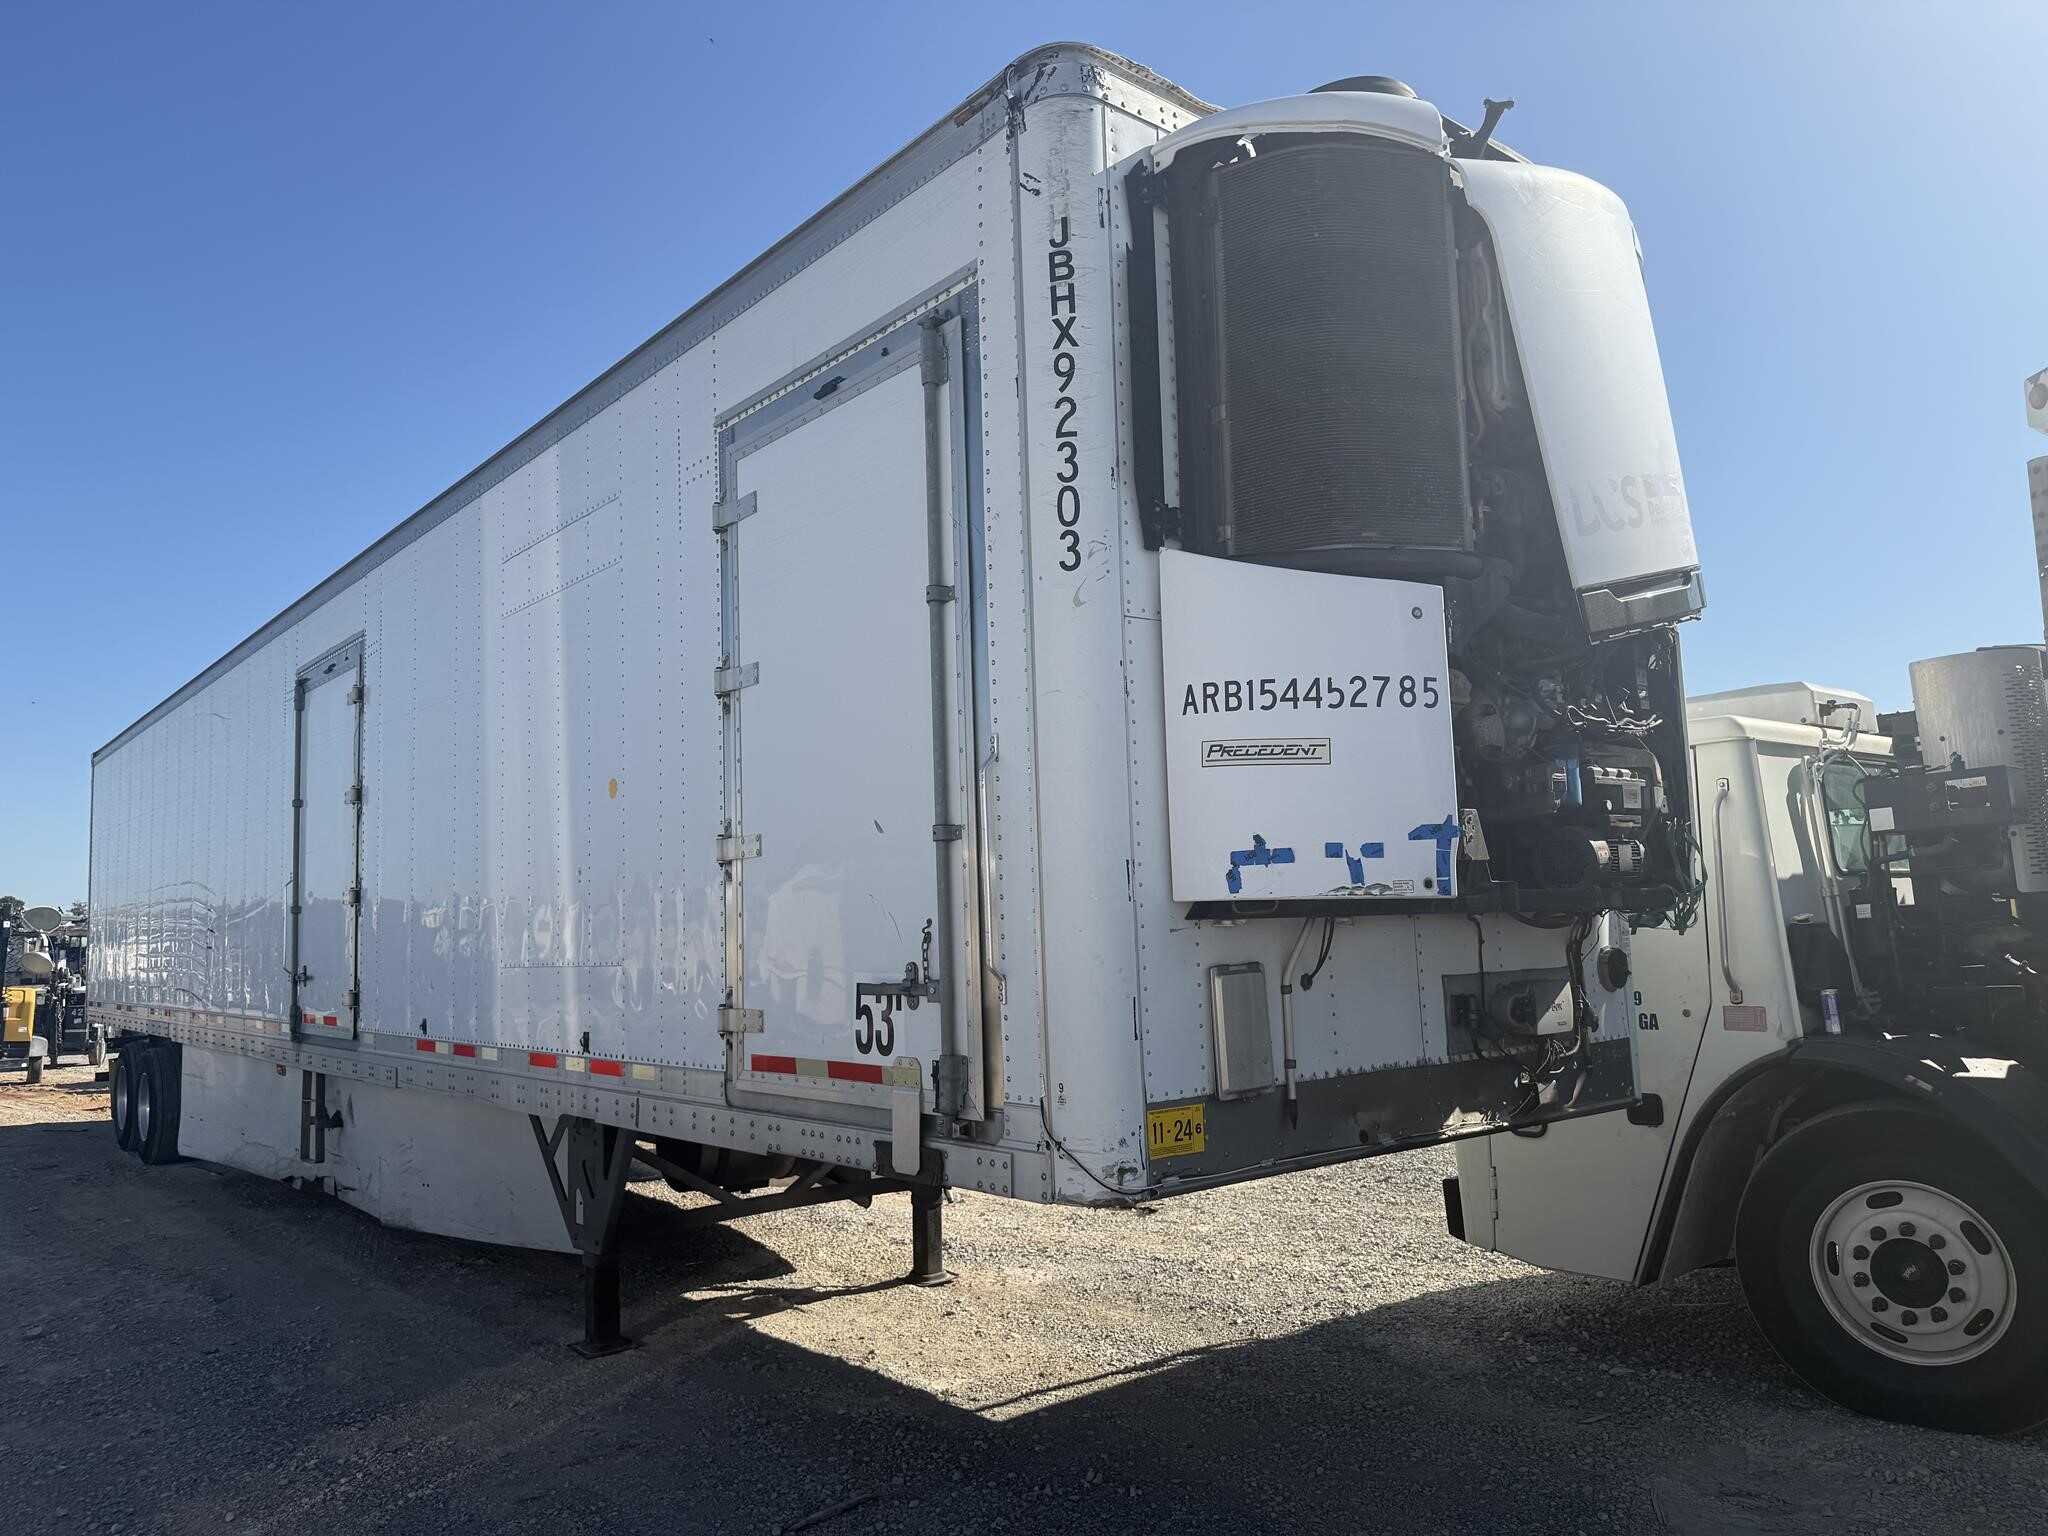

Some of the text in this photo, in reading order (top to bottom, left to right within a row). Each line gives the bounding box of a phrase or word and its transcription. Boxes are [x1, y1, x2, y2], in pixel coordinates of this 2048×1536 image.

[1048, 216, 1082, 572] JBHX92303
[1182, 675, 1440, 716] ARB154452785
[1206, 743, 1327, 759] PRECEDENT
[1638, 1013, 1660, 1031] GA
